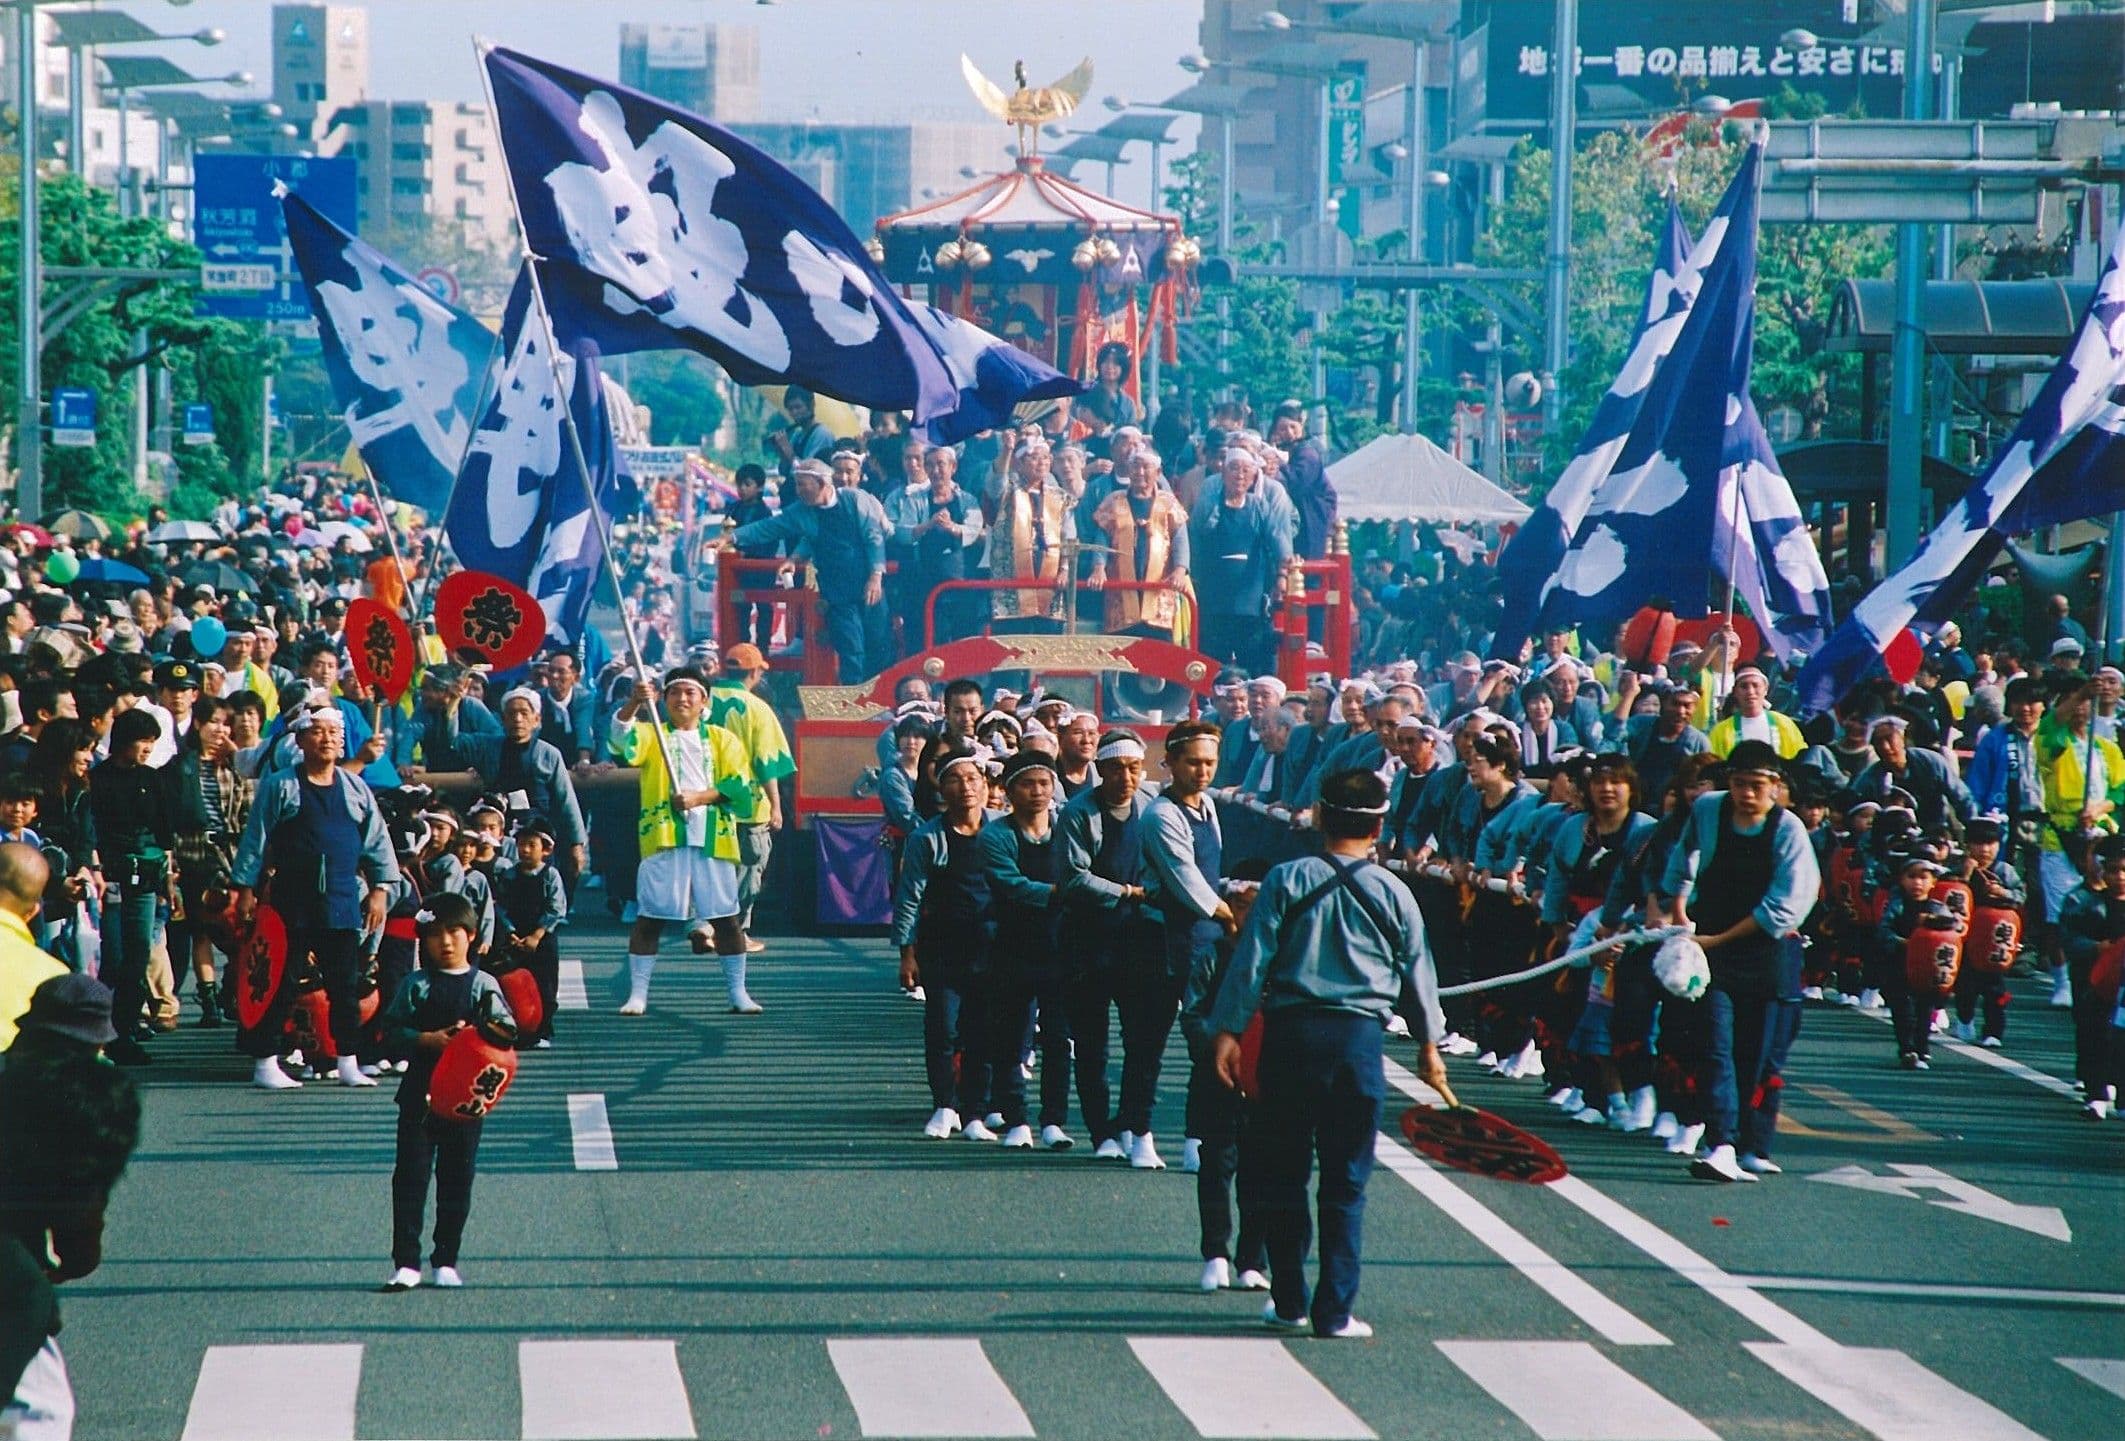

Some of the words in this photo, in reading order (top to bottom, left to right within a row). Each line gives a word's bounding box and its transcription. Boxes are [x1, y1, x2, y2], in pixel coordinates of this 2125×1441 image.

[266, 302, 305, 315] 250m
[364, 614, 397, 681] 祭
[463, 587, 523, 650] 祭
